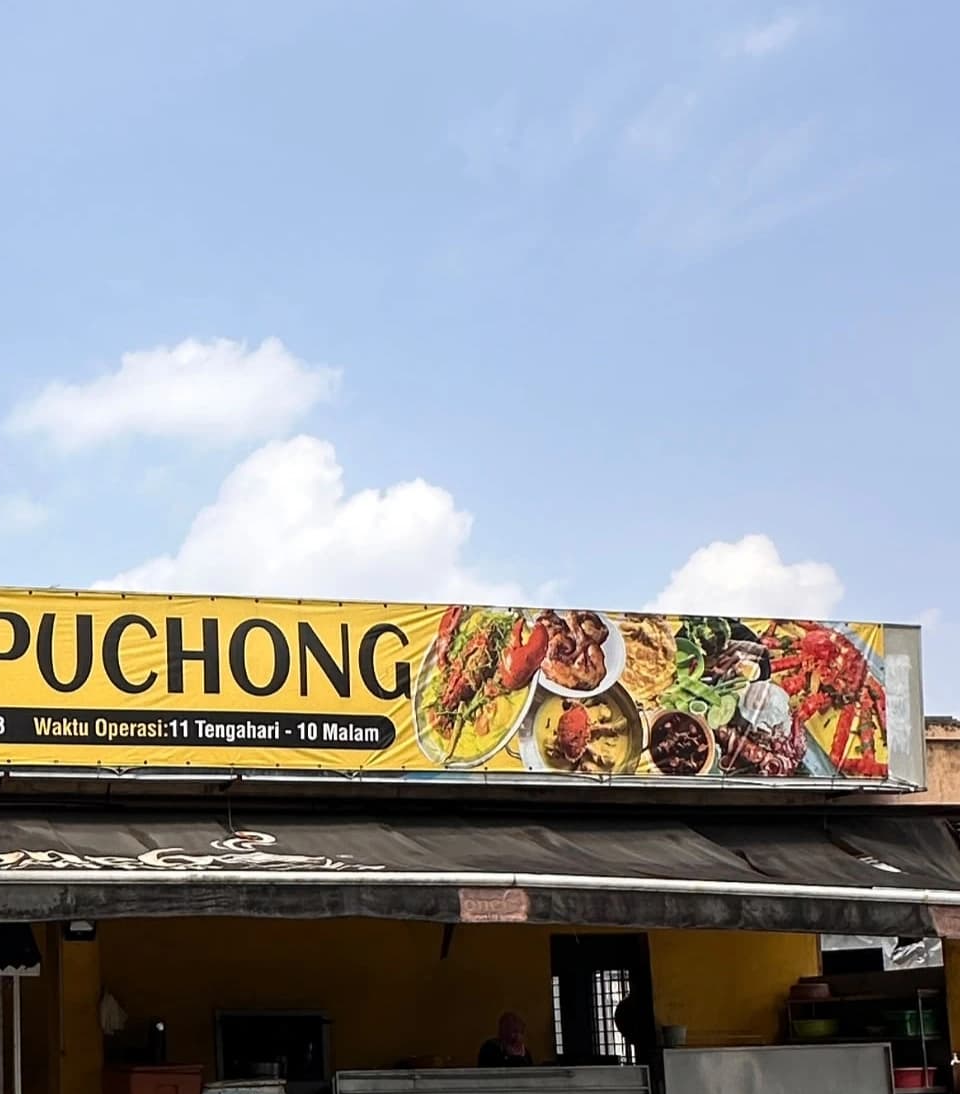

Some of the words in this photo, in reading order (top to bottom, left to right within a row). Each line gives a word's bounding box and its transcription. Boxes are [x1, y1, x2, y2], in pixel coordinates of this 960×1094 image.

[33, 717, 89, 737] Waktu
[194, 719, 280, 742] Tengahari
[297, 722, 318, 741] 10
[323, 723, 379, 742] Malam
